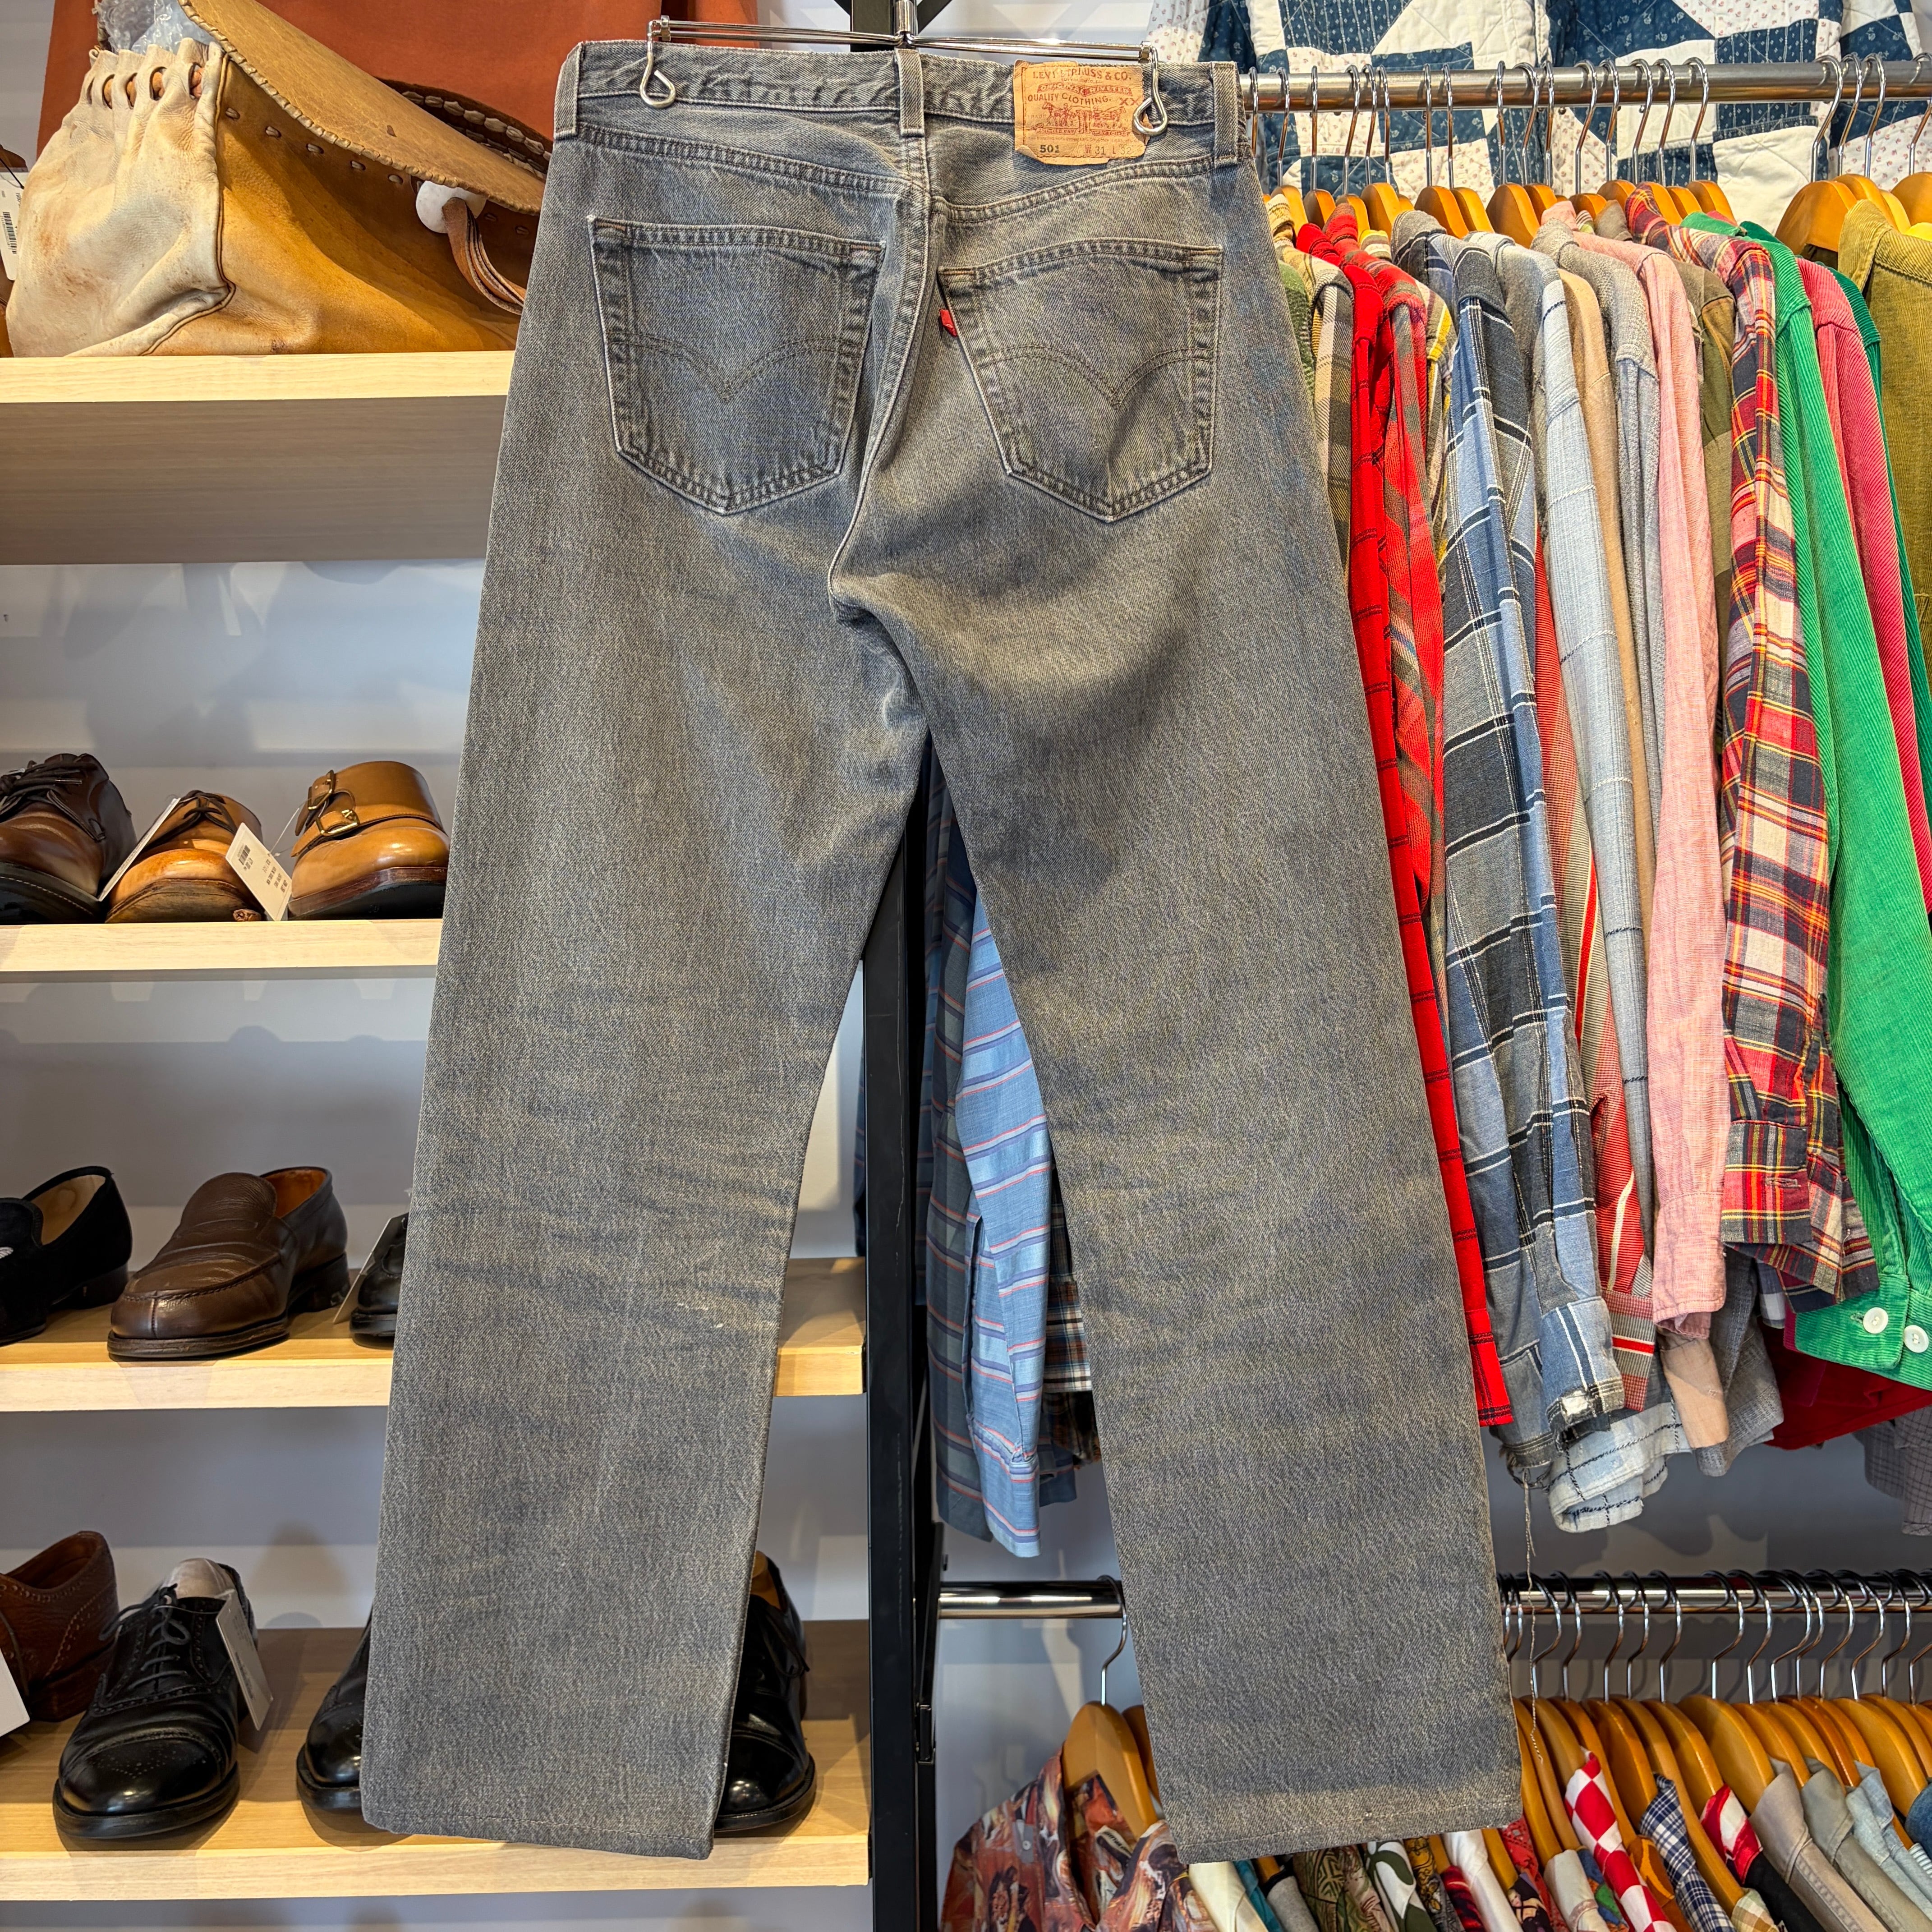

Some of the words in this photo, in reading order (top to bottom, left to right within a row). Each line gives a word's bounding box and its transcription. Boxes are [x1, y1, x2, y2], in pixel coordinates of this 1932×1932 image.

[1105, 71, 1112, 80] &
[1114, 71, 1131, 80] CO.
[1028, 93, 1059, 101] QUALITY
[1119, 97, 1140, 106] XX
[1040, 144, 1059, 153] 501
[1095, 146, 1106, 155] 31
[1112, 145, 1117, 154] L
